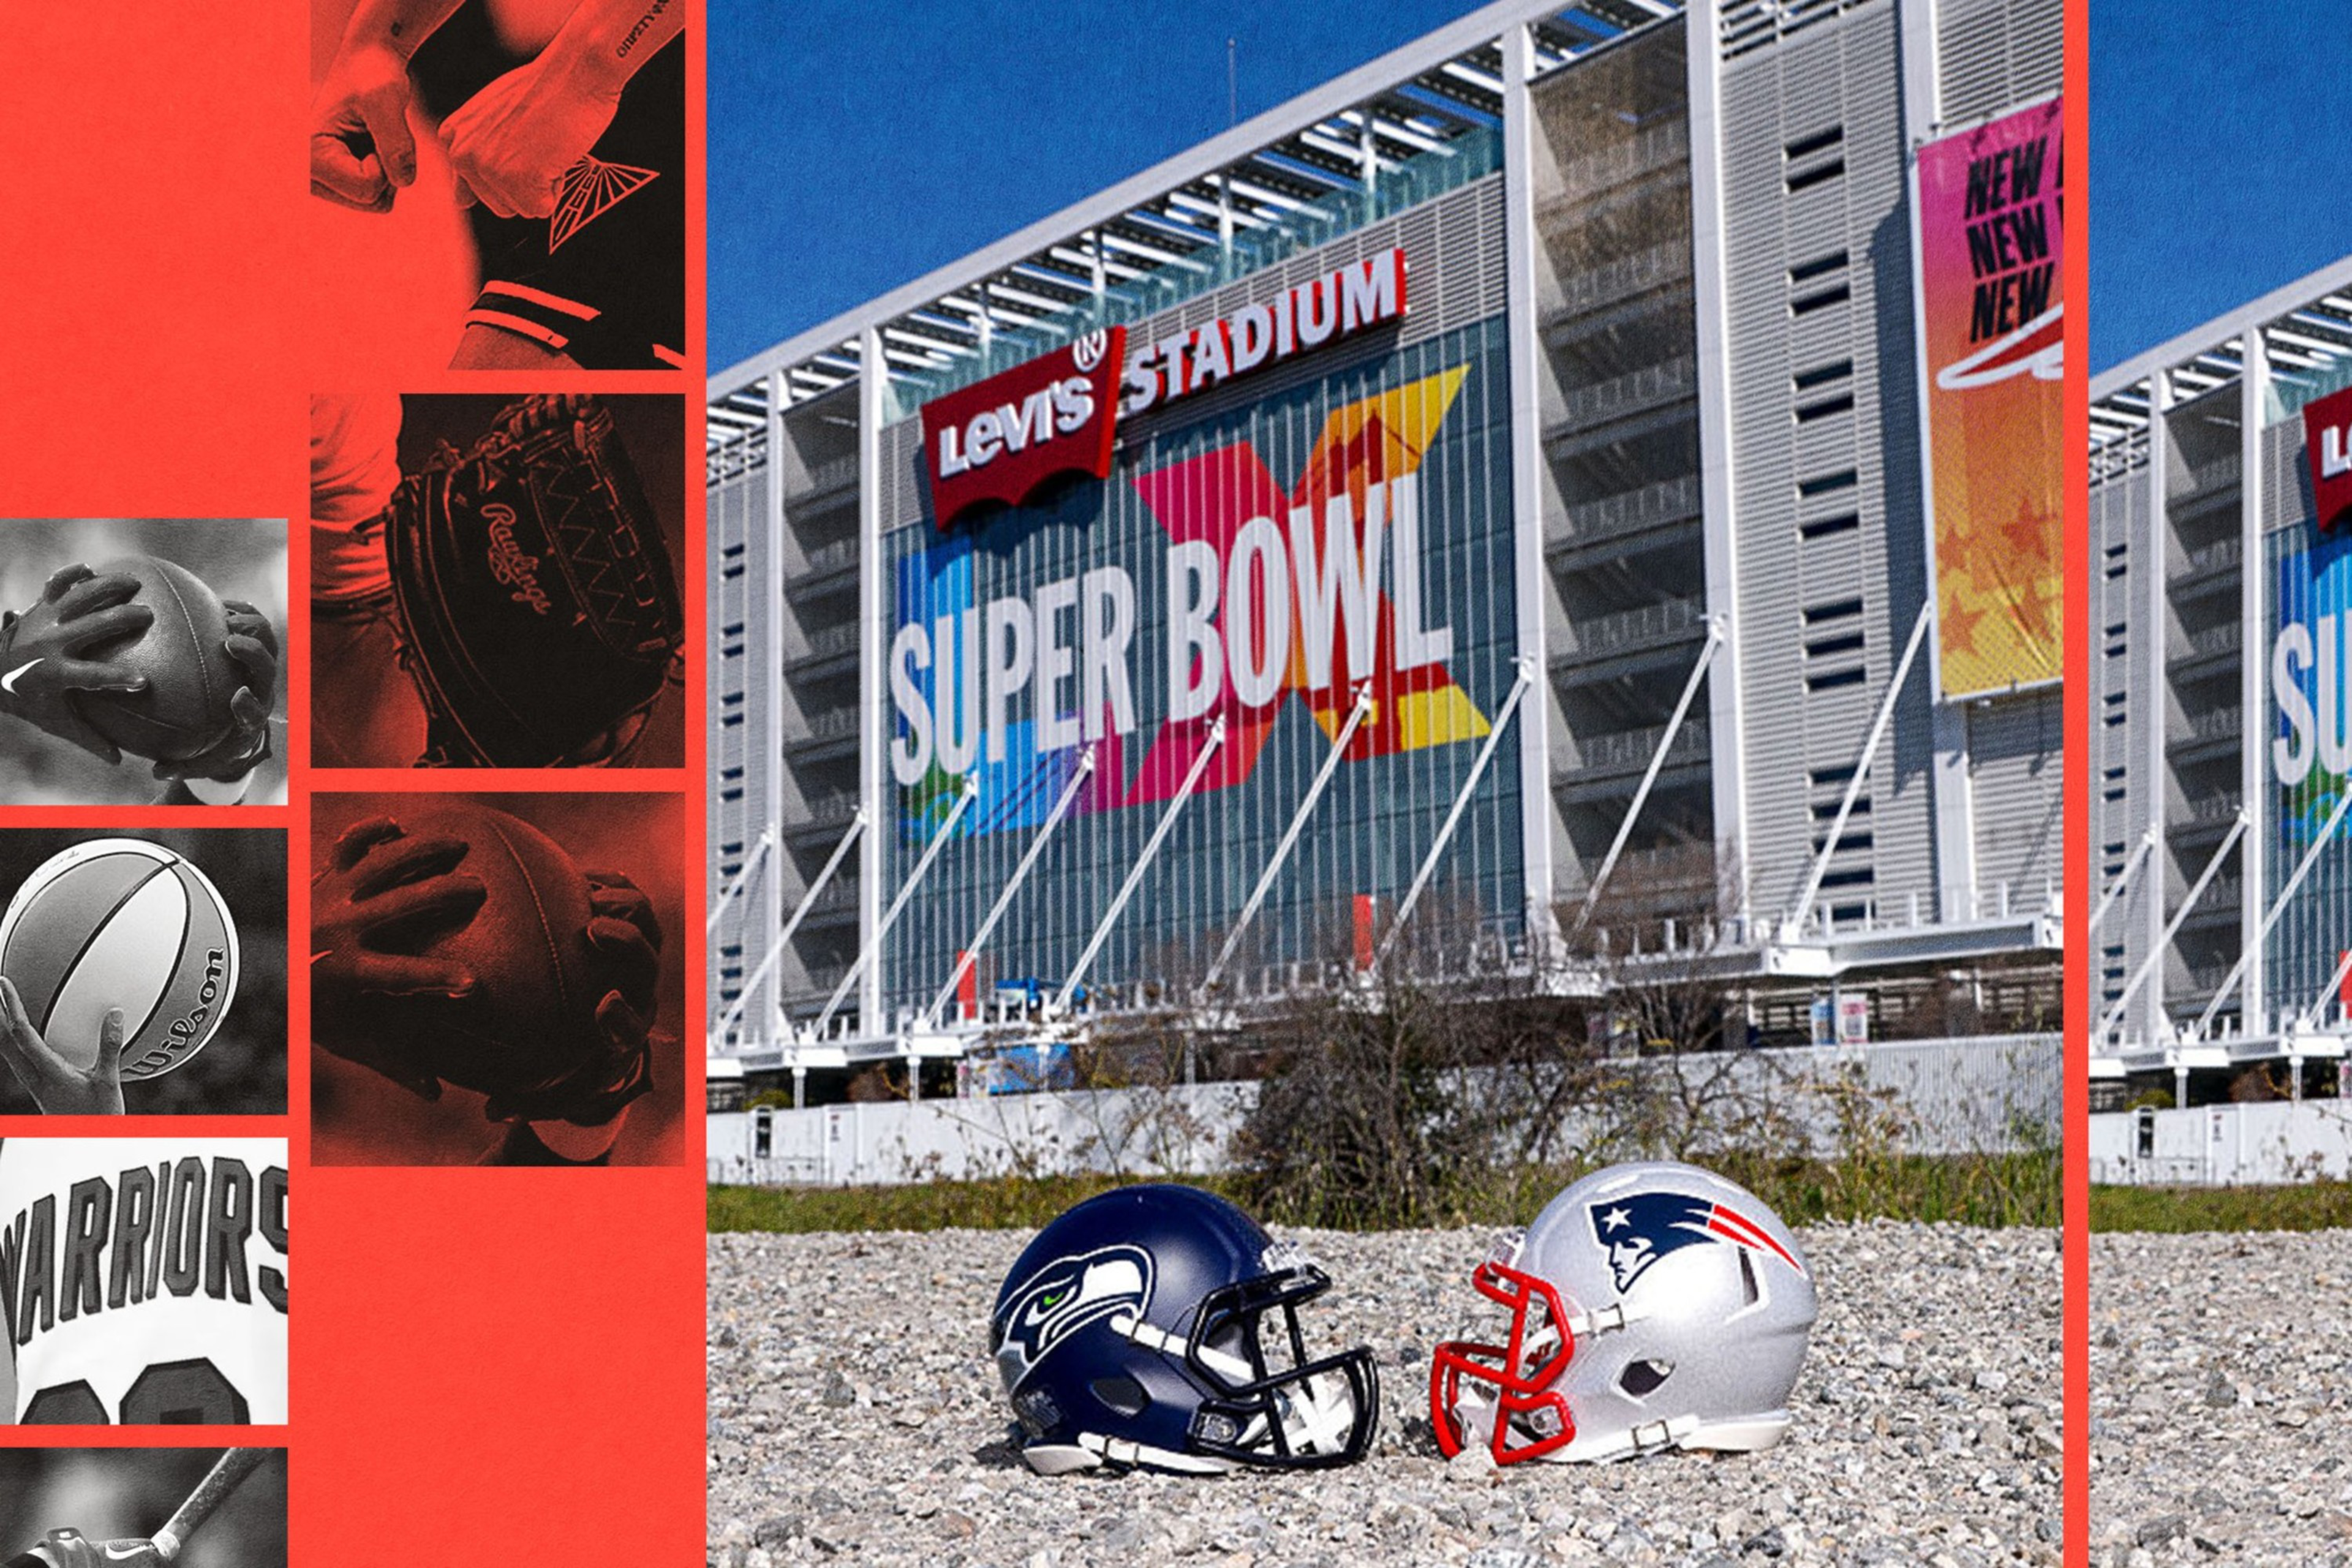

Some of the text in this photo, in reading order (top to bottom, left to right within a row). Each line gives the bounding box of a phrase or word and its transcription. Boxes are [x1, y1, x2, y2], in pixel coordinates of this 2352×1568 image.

[1964, 135, 2048, 219] NEW
[1966, 200, 2049, 277] NEW
[1126, 248, 1406, 413] STADIUM
[1970, 261, 2055, 342] NEW
[480, 503, 551, 615] Rawlings
[890, 471, 1453, 786] SUPER BOWL
[120, 948, 224, 1076] Wilson
[0, 1156, 288, 1348] WARRIORS
